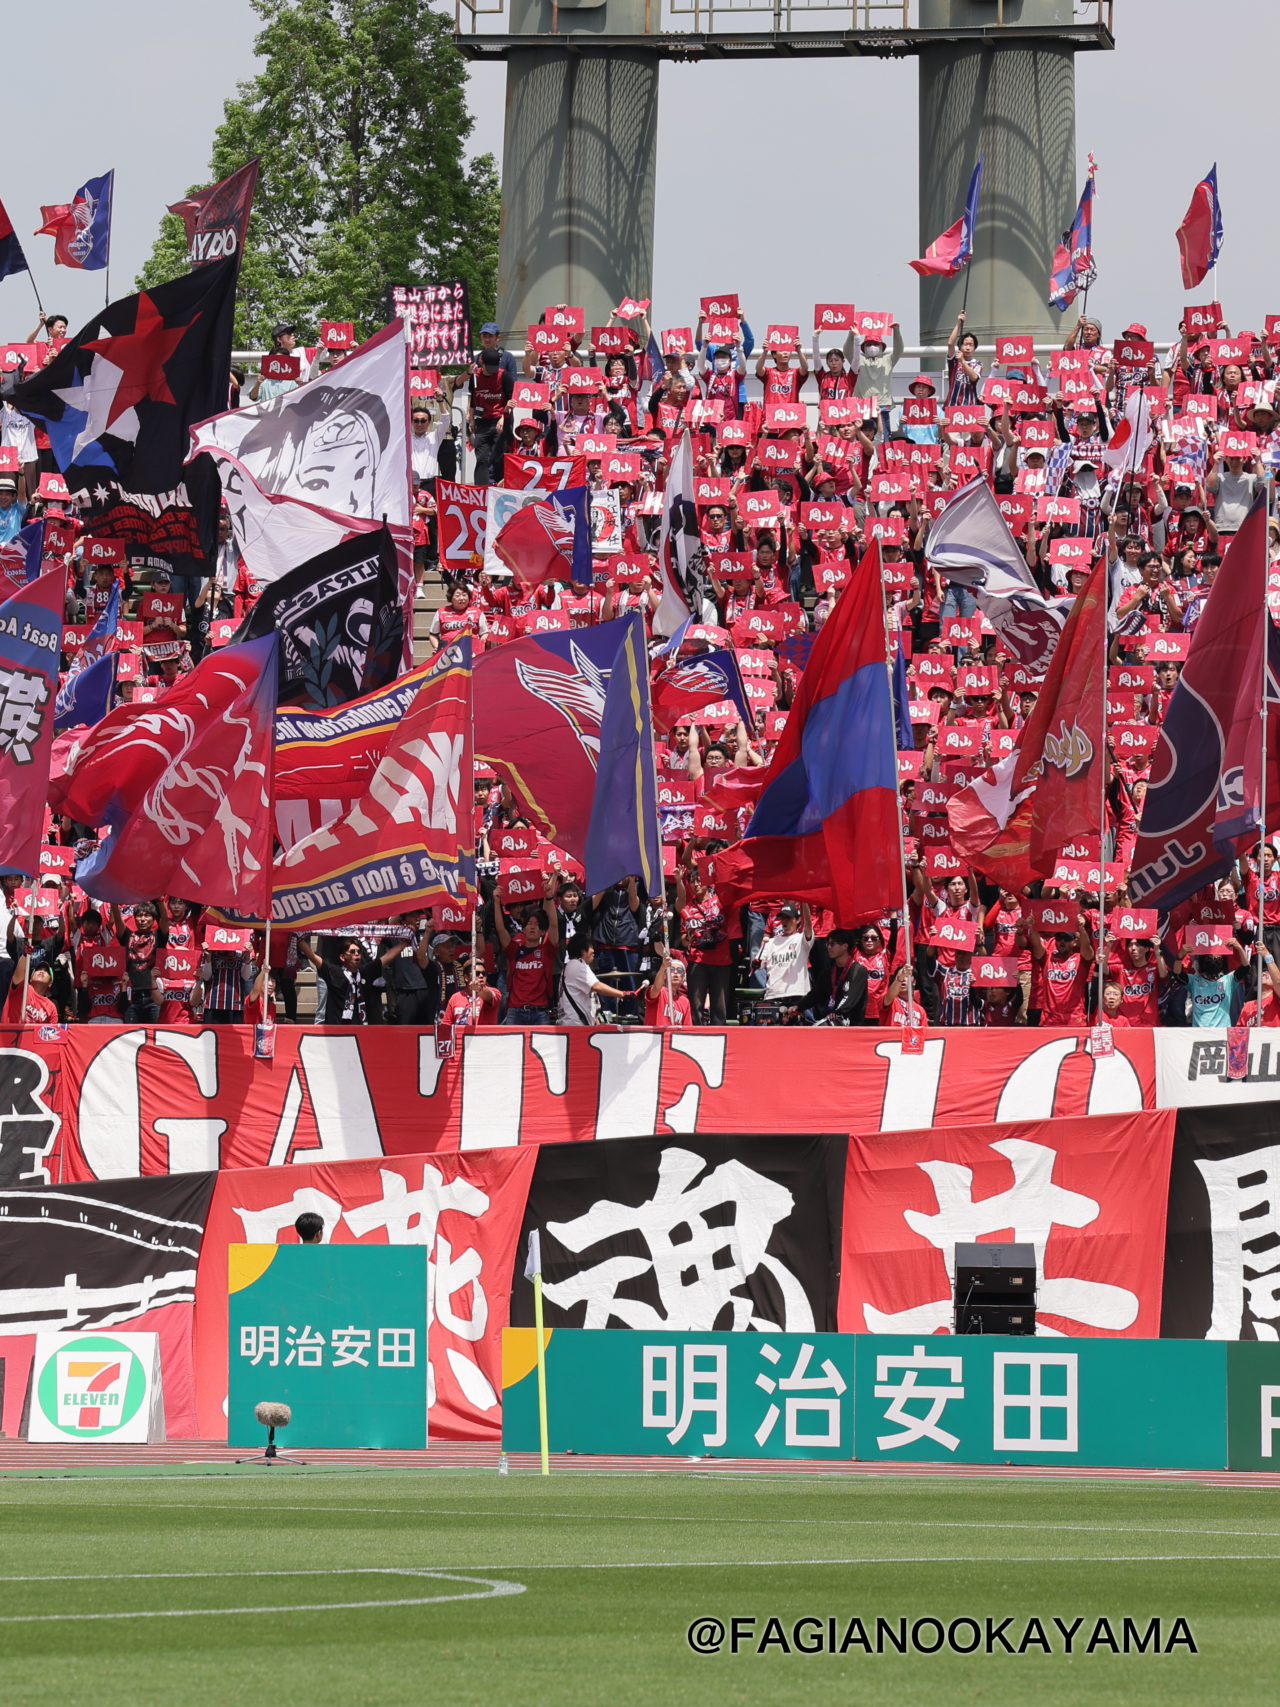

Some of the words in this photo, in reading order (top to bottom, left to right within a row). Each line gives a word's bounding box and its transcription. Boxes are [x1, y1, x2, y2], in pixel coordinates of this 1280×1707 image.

[392, 282, 464, 303] 福山市から
[709, 302, 731, 315] 岡山
[822, 310, 845, 323] 岡山
[1191, 312, 1214, 325] 岡山
[269, 360, 292, 373] 岡山
[410, 376, 432, 389] 岡山
[519, 388, 541, 402] 岡山
[1016, 390, 1039, 404] 岡山
[1227, 437, 1248, 450] 岡山
[522, 460, 574, 492] 27
[440, 483, 487, 507] MASAY
[699, 484, 722, 497] 岡山
[445, 505, 487, 560] 28
[1197, 537, 1204, 547] 5
[92, 544, 115, 557] 岡山
[1058, 544, 1083, 557] 岡山
[823, 569, 845, 583] 岡山
[96, 592, 109, 603] 88
[536, 616, 561, 630] 岡山
[949, 624, 972, 638] 岡山
[946, 733, 972, 747] 岡山
[1121, 731, 1147, 746] 岡山
[702, 815, 727, 830] 岡山
[502, 836, 527, 850] 岡山
[40, 851, 64, 866] 岡山
[934, 854, 960, 868] 岡山
[1120, 915, 1147, 930] 岡山
[92, 954, 117, 968] 岡山
[981, 964, 1007, 979] 岡山
[438, 1040, 451, 1052] 27
[80, 1028, 726, 1181] GATE
[240, 1325, 415, 1368] 明治安田
[642, 1342, 1080, 1452] 明治安田
